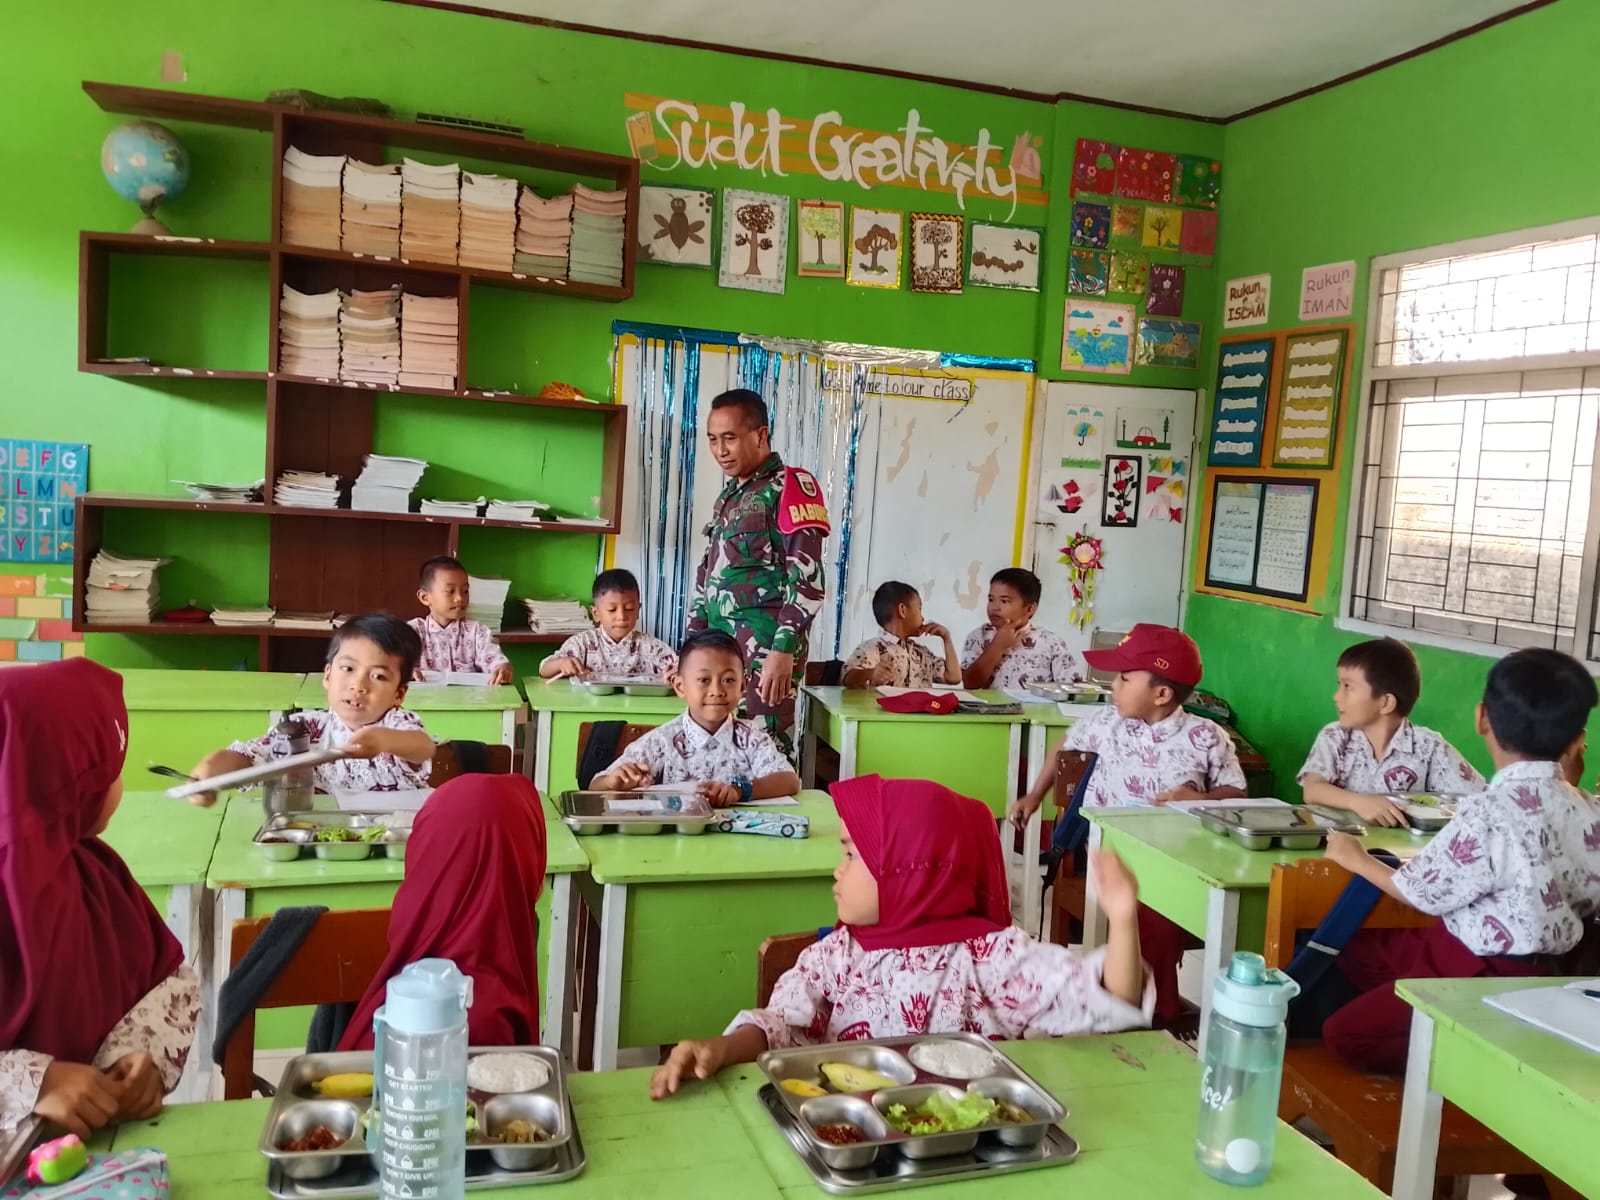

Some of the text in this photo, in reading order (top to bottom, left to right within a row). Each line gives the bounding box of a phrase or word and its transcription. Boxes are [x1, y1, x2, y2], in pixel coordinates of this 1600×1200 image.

[647, 100, 1018, 223] Sudut Creativity
[1229, 282, 1261, 301] Rukun
[1306, 269, 1350, 293] Rukun
[1227, 303, 1266, 321] ISLAM
[1303, 296, 1349, 314] IMAN
[885, 376, 899, 394] to
[904, 382, 923, 395] our
[933, 378, 969, 400] class
[16, 448, 29, 467] E
[41, 449, 53, 468] F
[62, 451, 77, 470] G
[16, 477, 28, 496] L
[38, 479, 54, 497] M
[61, 479, 76, 498] N
[16, 505, 28, 525] S
[38, 507, 51, 526] T
[62, 508, 74, 527] U
[15, 535, 27, 553] Y
[39, 535, 51, 554] Z
[1154, 657, 1170, 671] SD
